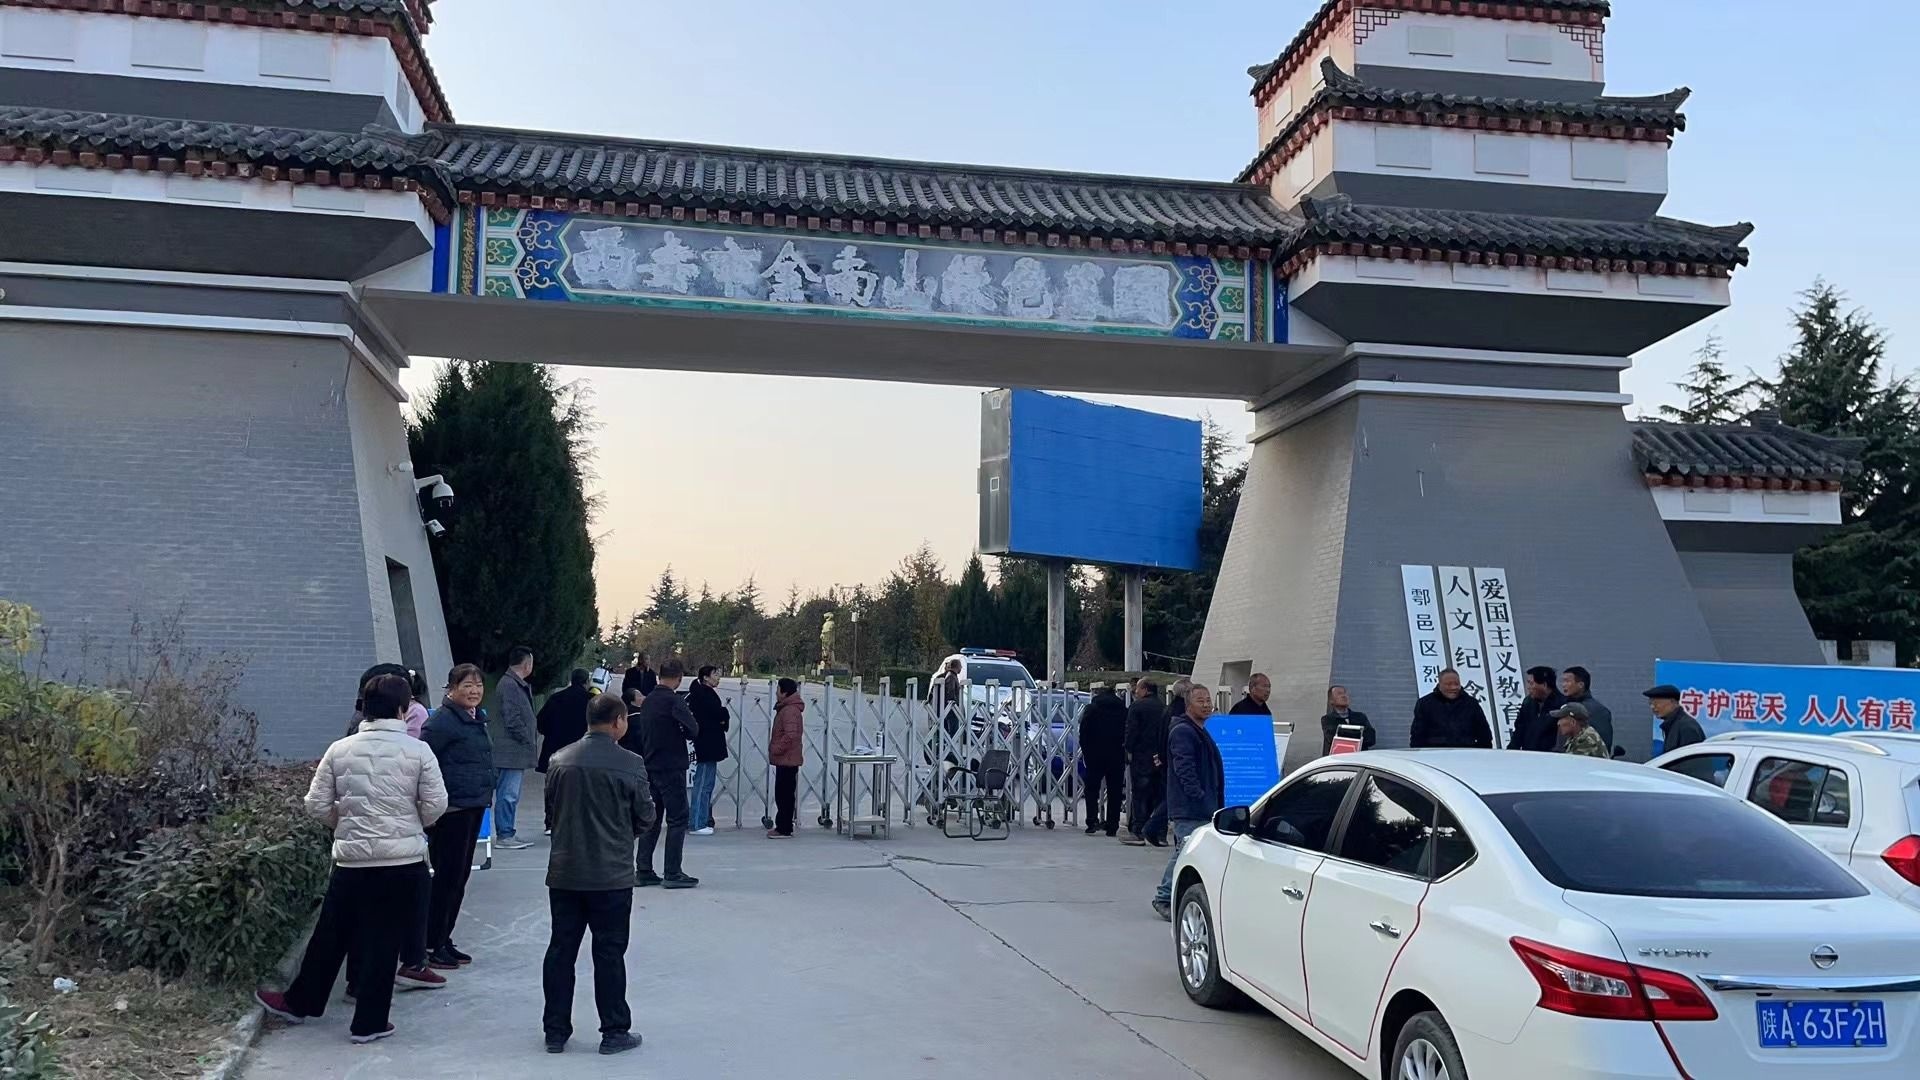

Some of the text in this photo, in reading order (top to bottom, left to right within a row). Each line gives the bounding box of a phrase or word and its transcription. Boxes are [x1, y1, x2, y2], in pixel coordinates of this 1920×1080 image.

[1681, 690, 1915, 730] 守护蓝天 人人有责
